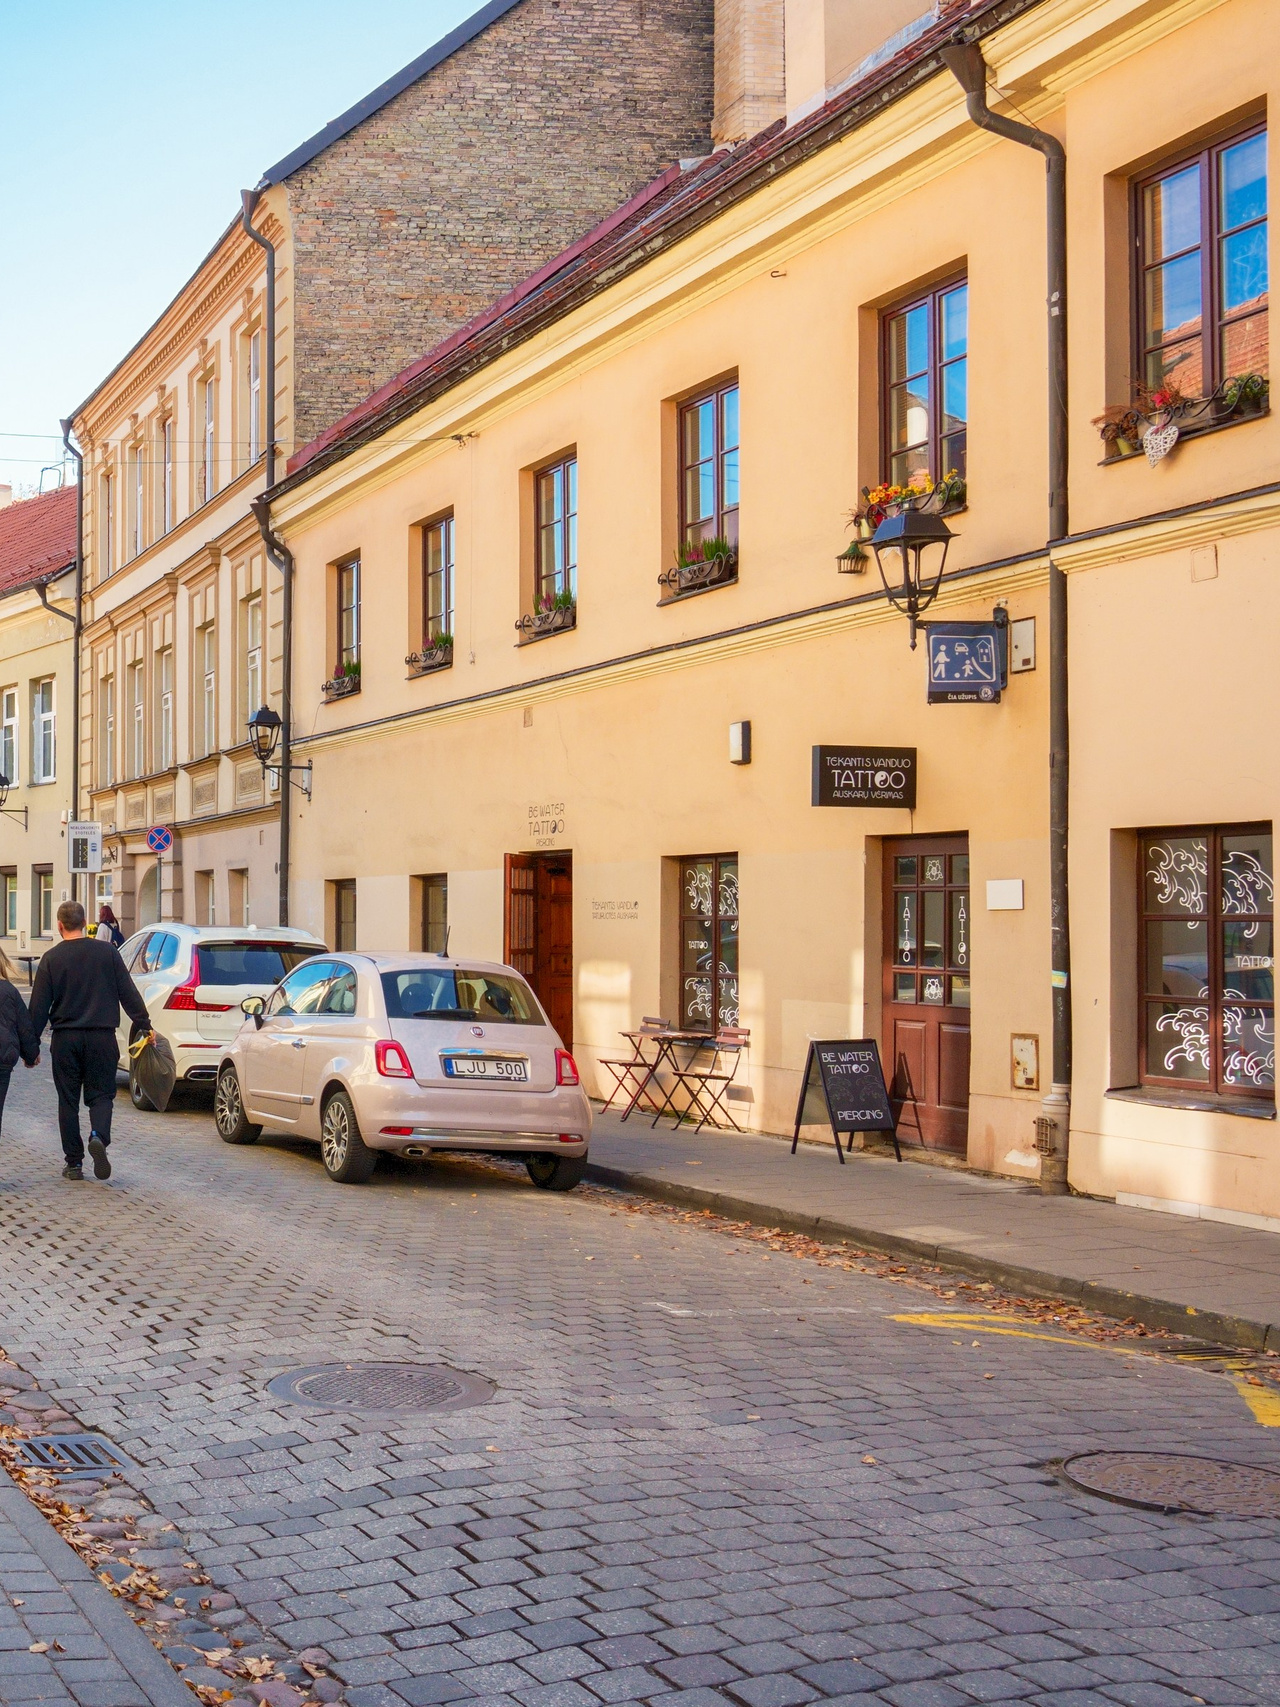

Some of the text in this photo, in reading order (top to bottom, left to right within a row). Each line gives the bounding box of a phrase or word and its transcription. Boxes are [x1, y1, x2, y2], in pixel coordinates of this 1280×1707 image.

[826, 757, 911, 768] TEKANTIS VANDUO
[831, 770, 906, 789] TATTOO
[528, 803, 566, 818] BE WATER
[528, 819, 565, 836] TATTOO
[903, 896, 911, 963] TATTOO
[958, 896, 966, 965] TATTOO
[688, 940, 708, 949] TATTOO
[821, 1051, 874, 1063] BE WATER
[454, 1061, 487, 1074] LJU
[496, 1062, 523, 1076] 500
[827, 1063, 869, 1074] TATTOO
[837, 1109, 884, 1121] PIERCING
